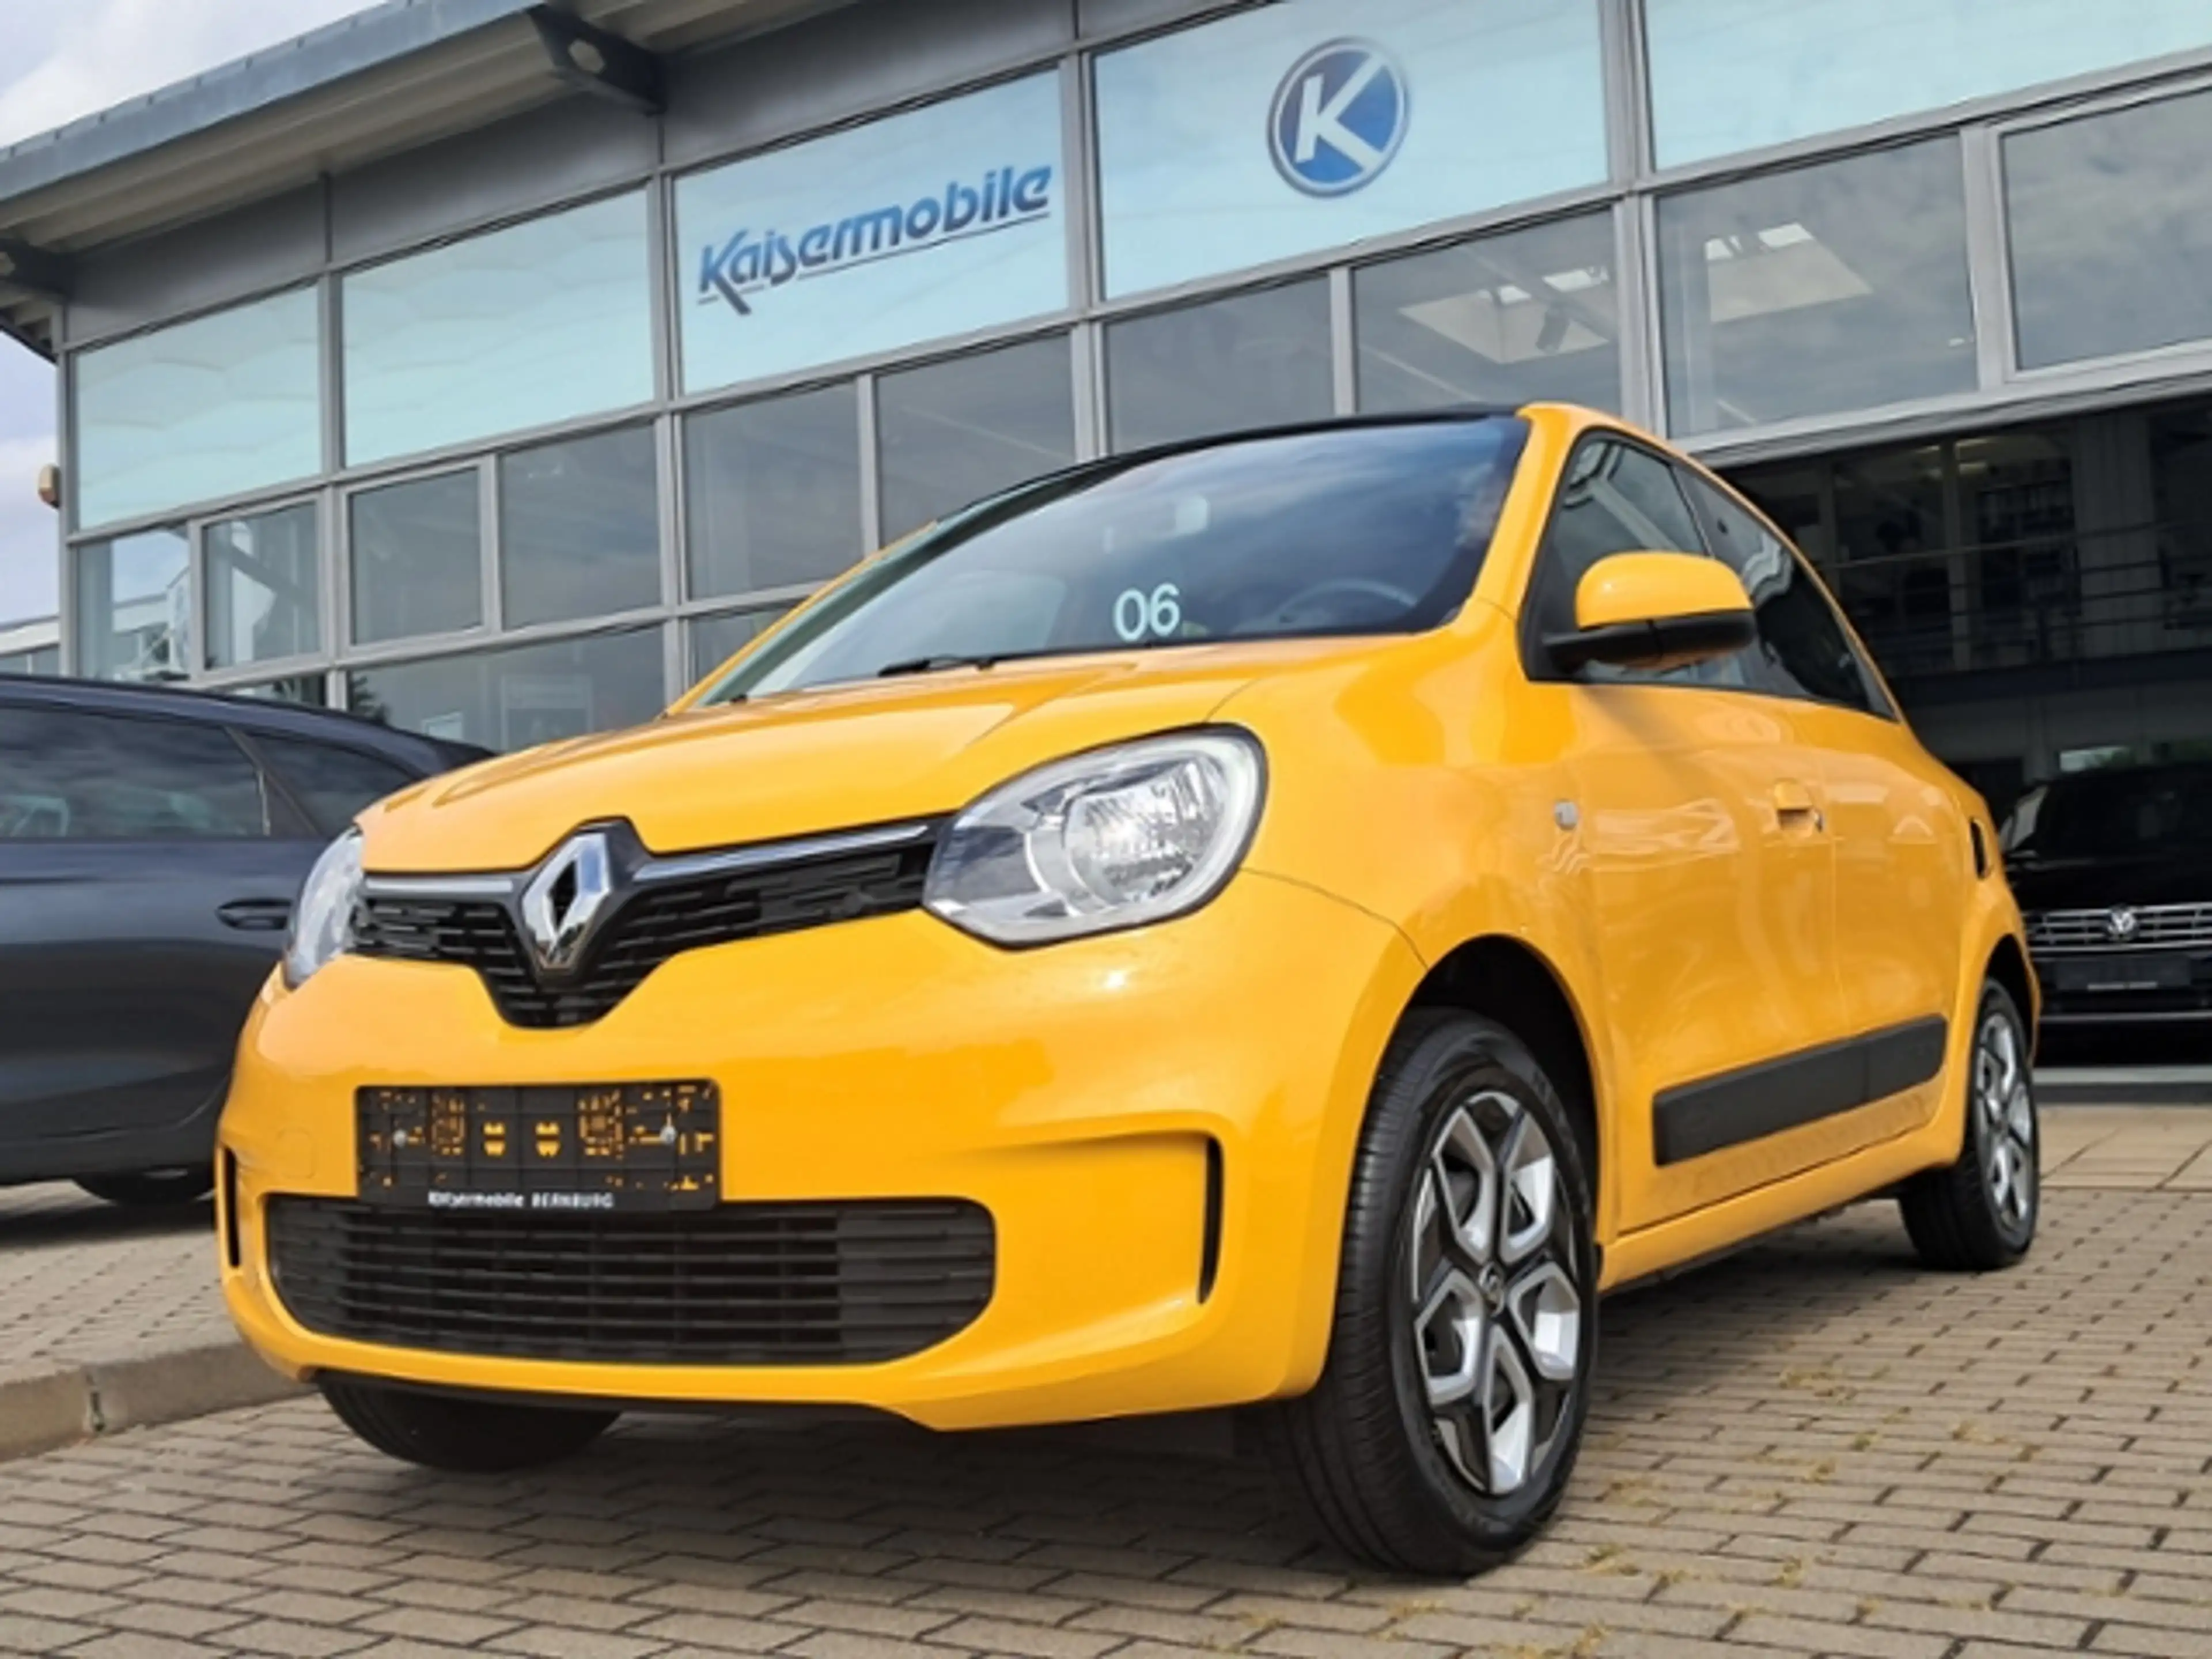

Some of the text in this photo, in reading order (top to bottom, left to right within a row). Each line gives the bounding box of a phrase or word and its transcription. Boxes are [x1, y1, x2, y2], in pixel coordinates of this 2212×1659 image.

[1293, 51, 1389, 176] K
[699, 165, 1052, 315] Kaisermobile
[1113, 581, 1180, 643] 06
[532, 1192, 614, 1209] BERNBURG
